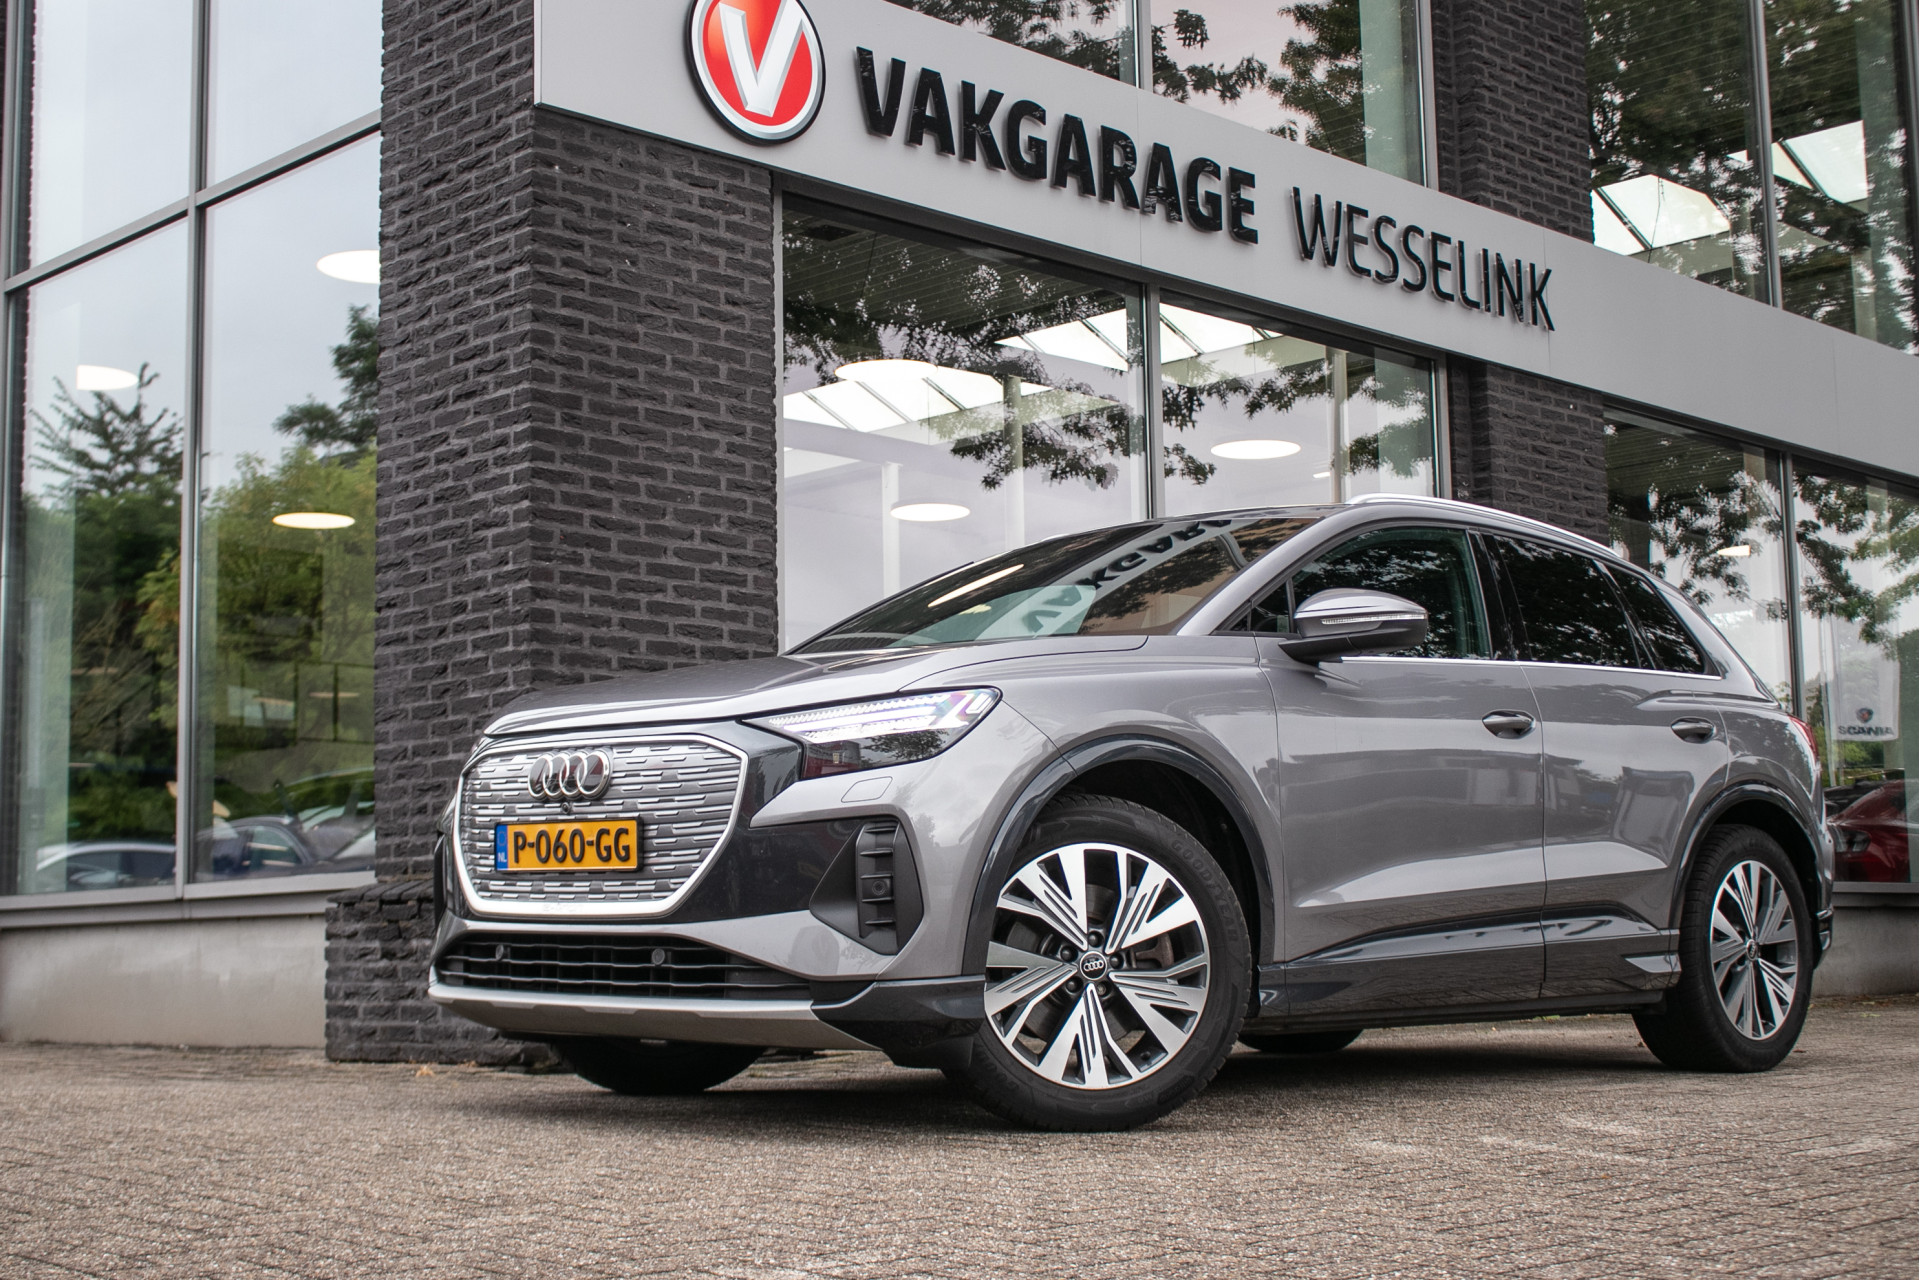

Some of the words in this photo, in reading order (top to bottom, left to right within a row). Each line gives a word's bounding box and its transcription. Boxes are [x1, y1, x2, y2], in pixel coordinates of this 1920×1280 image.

[718, 0, 804, 118] V
[856, 46, 1259, 245] VAKGARAGE
[1292, 186, 1556, 332] WESSELINK
[1837, 725, 1894, 737] SCANIA
[497, 852, 508, 863] NL
[513, 827, 631, 865] P-060-GG
